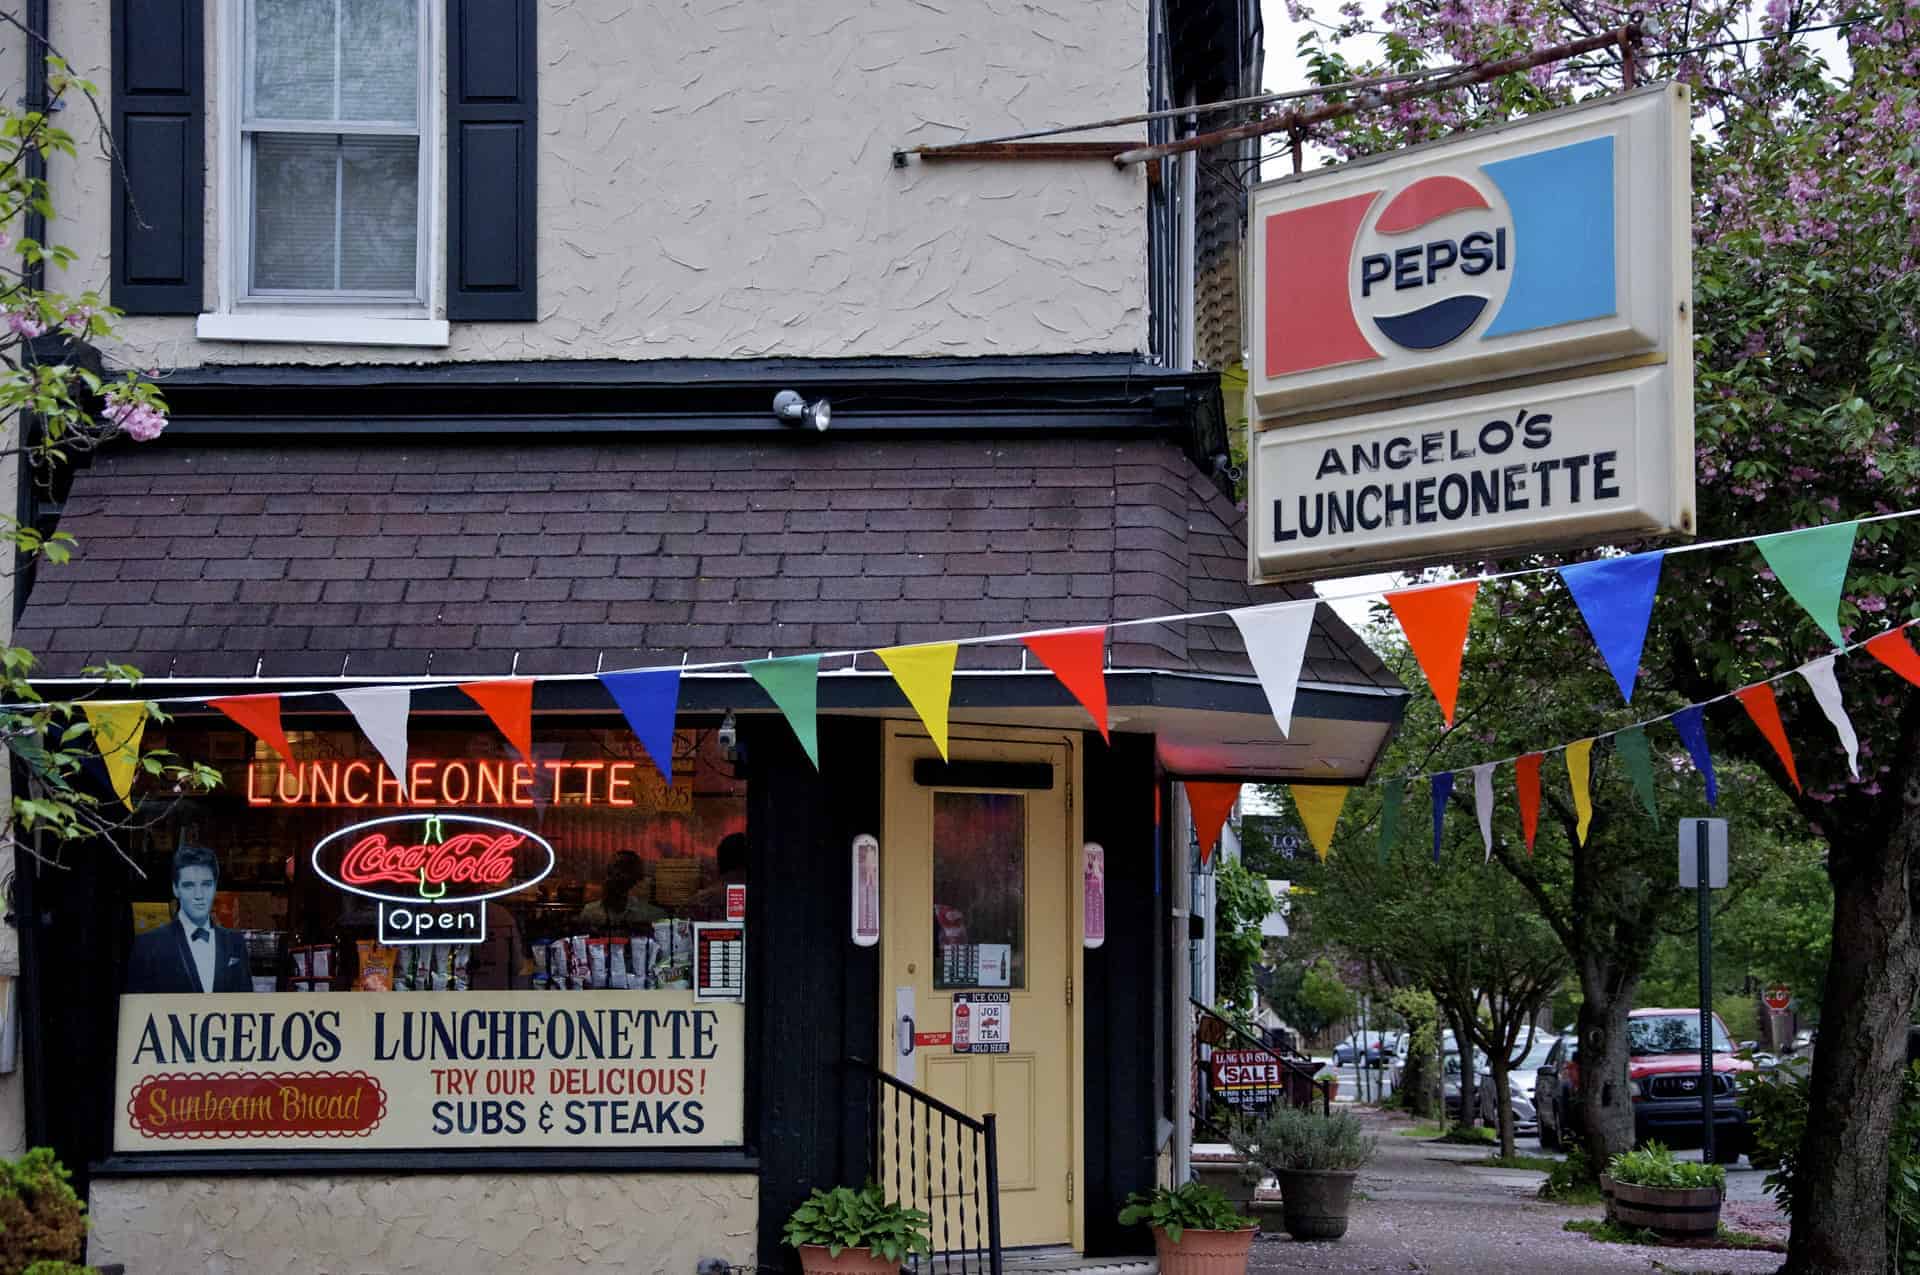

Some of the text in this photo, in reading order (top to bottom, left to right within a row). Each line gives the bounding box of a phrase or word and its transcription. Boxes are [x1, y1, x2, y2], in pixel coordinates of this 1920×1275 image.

[1361, 227, 1506, 297] PEPSI
[1315, 409, 1553, 480] ANGELO'S
[1273, 450, 1620, 543] LUNCHEONETTE
[246, 761, 636, 807] LUNCHEONETTE
[388, 908, 475, 936] Open
[972, 990, 1008, 1001] ICE COLD
[981, 1007, 999, 1017] JOE
[132, 1009, 719, 1065] ANGELO'S LUNCHEONETTE
[981, 1029, 999, 1039] TEA
[431, 1068, 707, 1096] TRY OUR DELICIOUS!
[1226, 1066, 1277, 1082] SALE
[149, 1085, 362, 1127] Sunbeam Bread
[432, 1100, 706, 1135] SUBS & STEAKS
